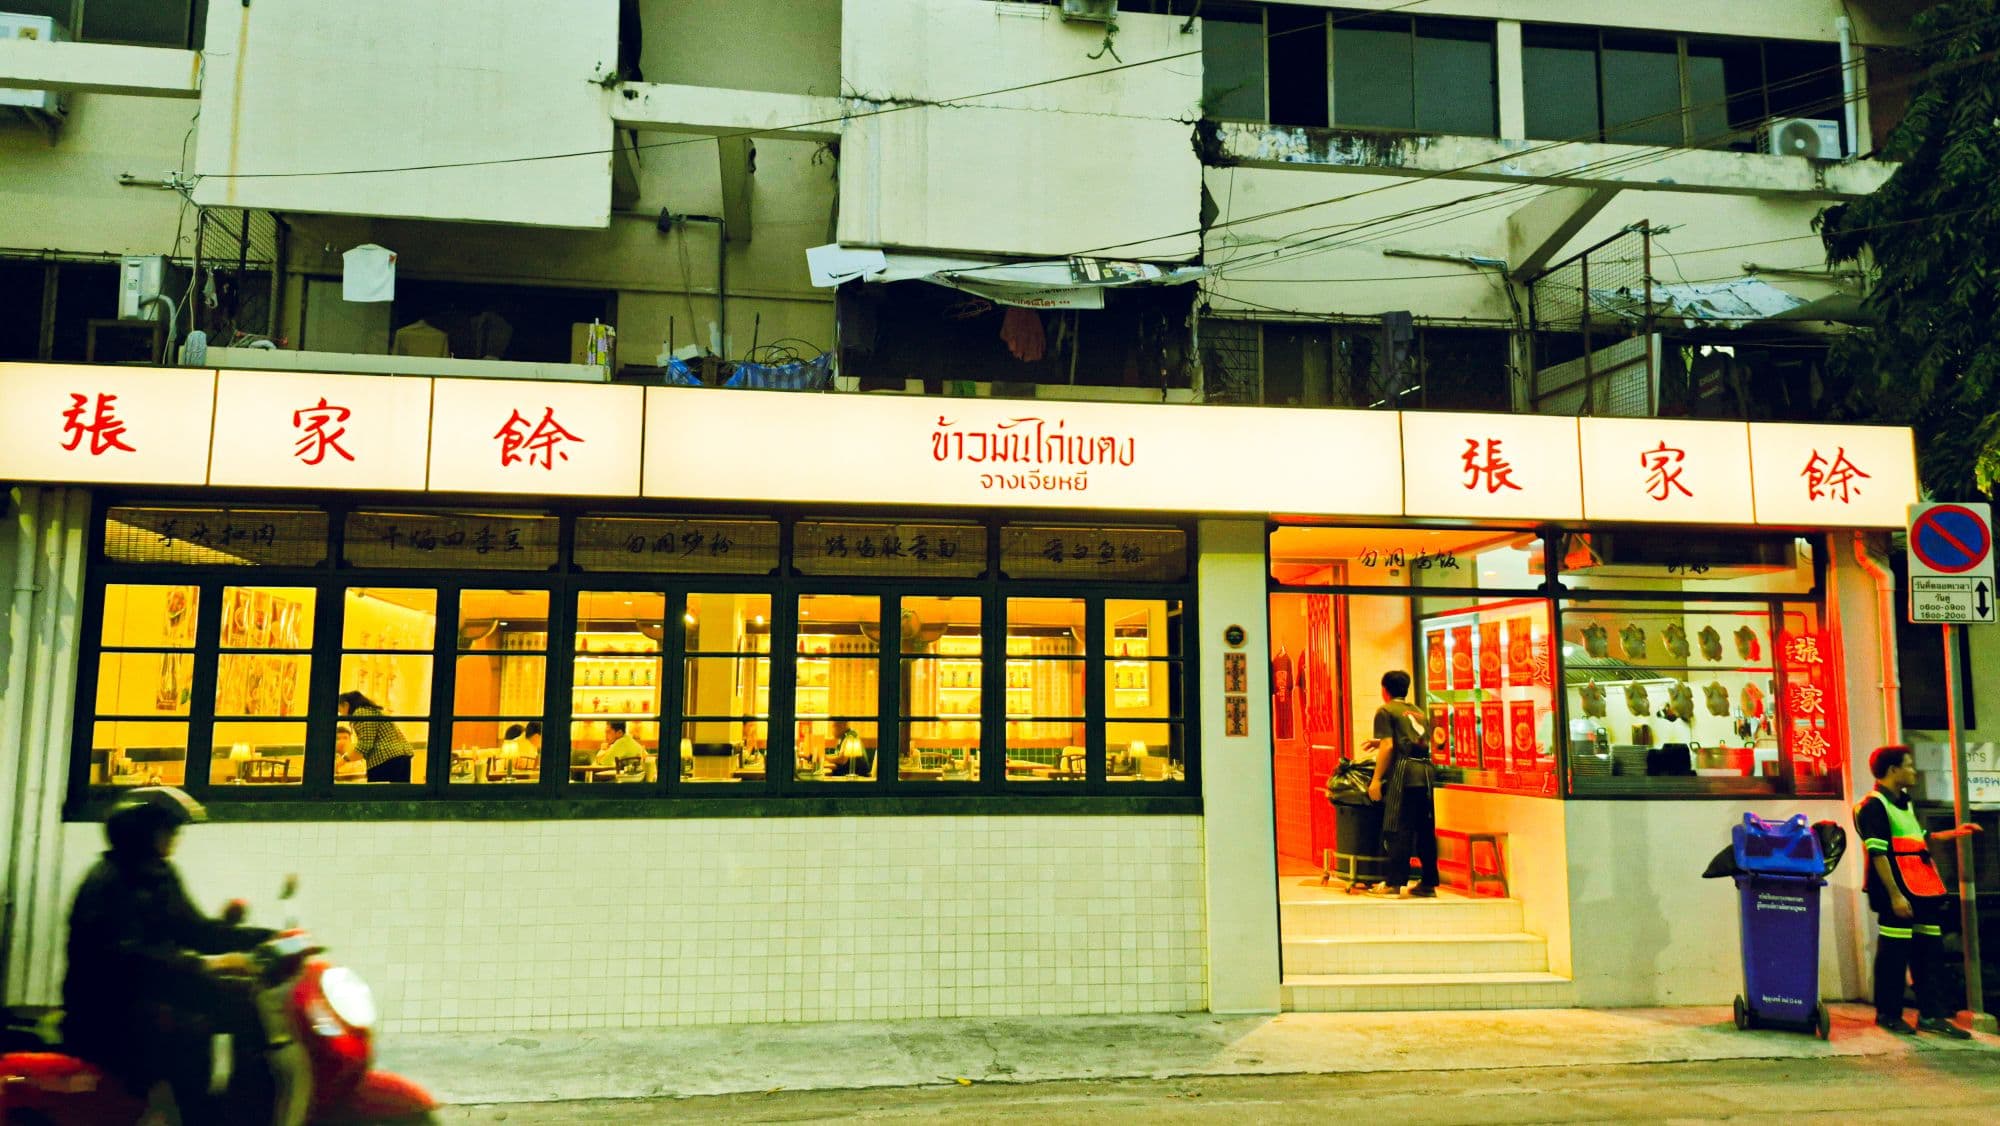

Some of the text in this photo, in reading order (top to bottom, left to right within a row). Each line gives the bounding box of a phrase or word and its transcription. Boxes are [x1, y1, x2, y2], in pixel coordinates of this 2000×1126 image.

[931, 415, 1135, 466] ข้าวมันไก่เบตง
[980, 469, 1088, 490] จางเจียหยี
[1919, 603, 1966, 611] 0600-0900
